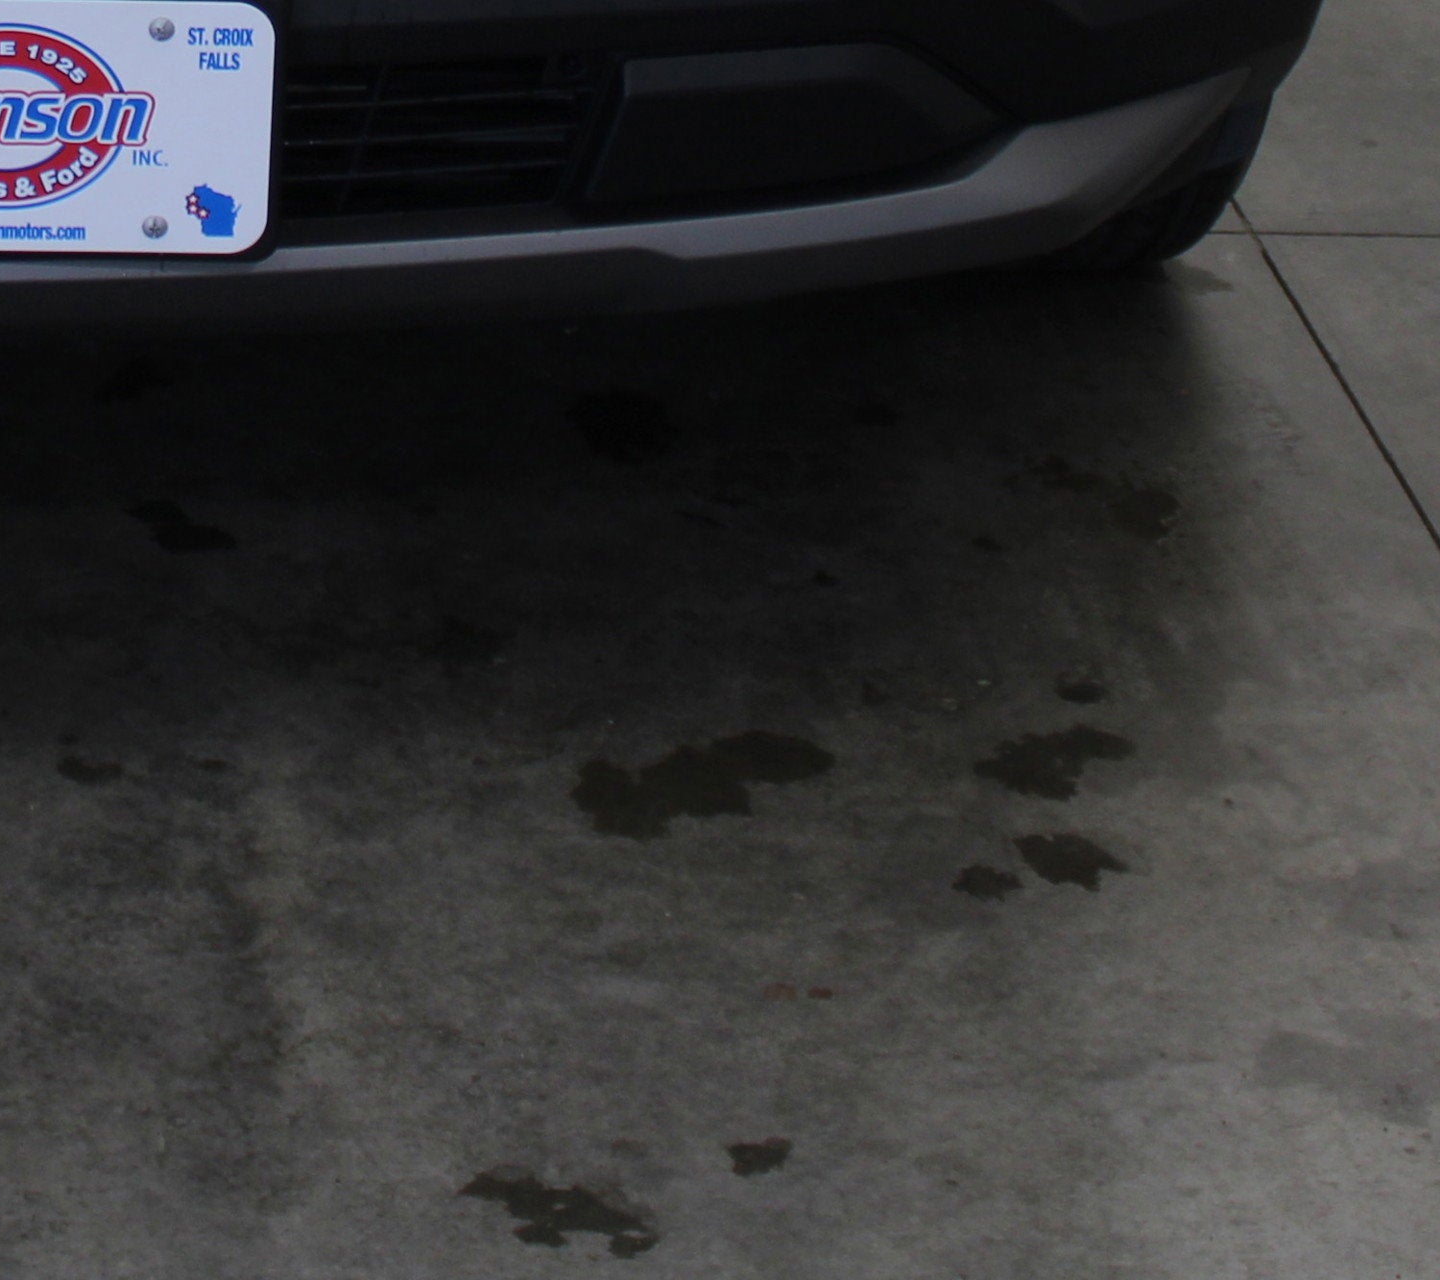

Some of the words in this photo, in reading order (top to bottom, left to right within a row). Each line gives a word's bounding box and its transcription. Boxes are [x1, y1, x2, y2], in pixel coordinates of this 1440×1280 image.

[188, 28, 210, 46] ST.
[213, 28, 254, 47] CROIX
[28, 44, 90, 85] 1925
[199, 52, 240, 70] FALLS
[132, 150, 168, 167] INC.
[14, 178, 36, 198] &
[40, 147, 98, 194] Ford
